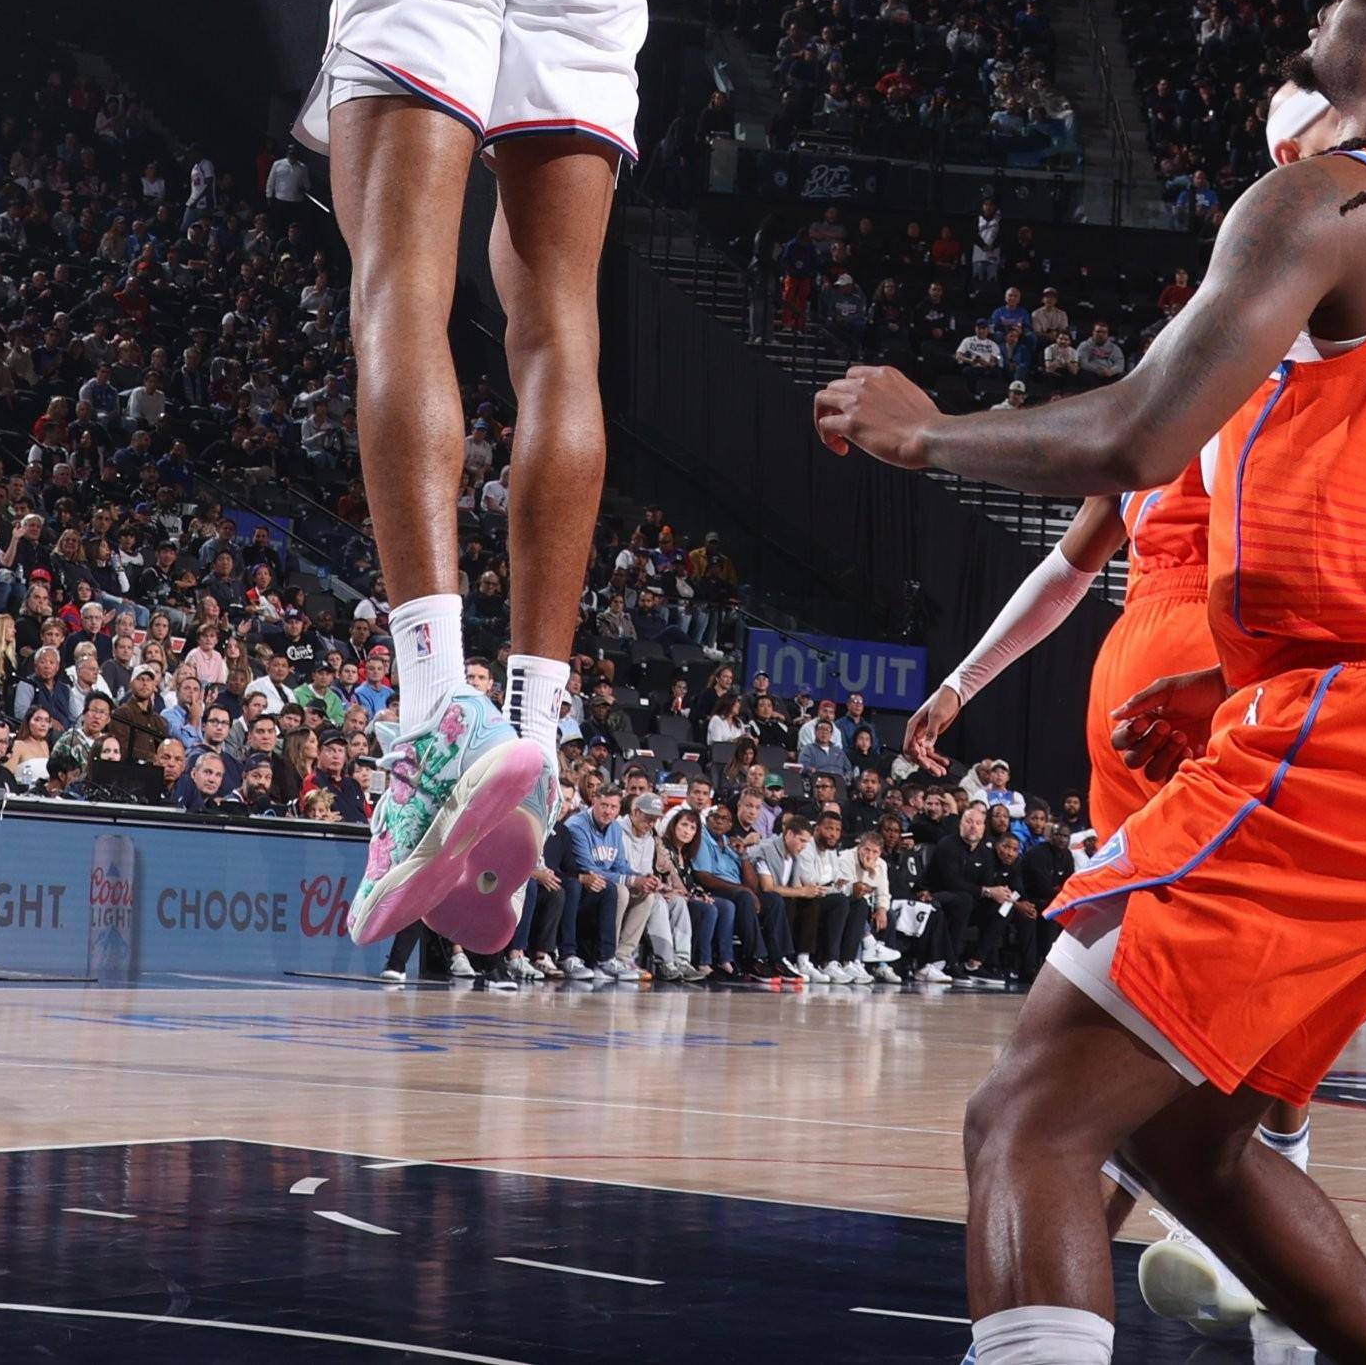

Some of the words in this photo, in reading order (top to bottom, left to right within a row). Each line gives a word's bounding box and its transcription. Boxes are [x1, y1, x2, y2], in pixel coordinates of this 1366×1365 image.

[757, 641, 918, 701] INTUIT
[906, 857, 917, 876] G
[89, 868, 134, 906] Coors
[90, 907, 134, 928] LIGHT
[157, 886, 288, 933] CHOOSE
